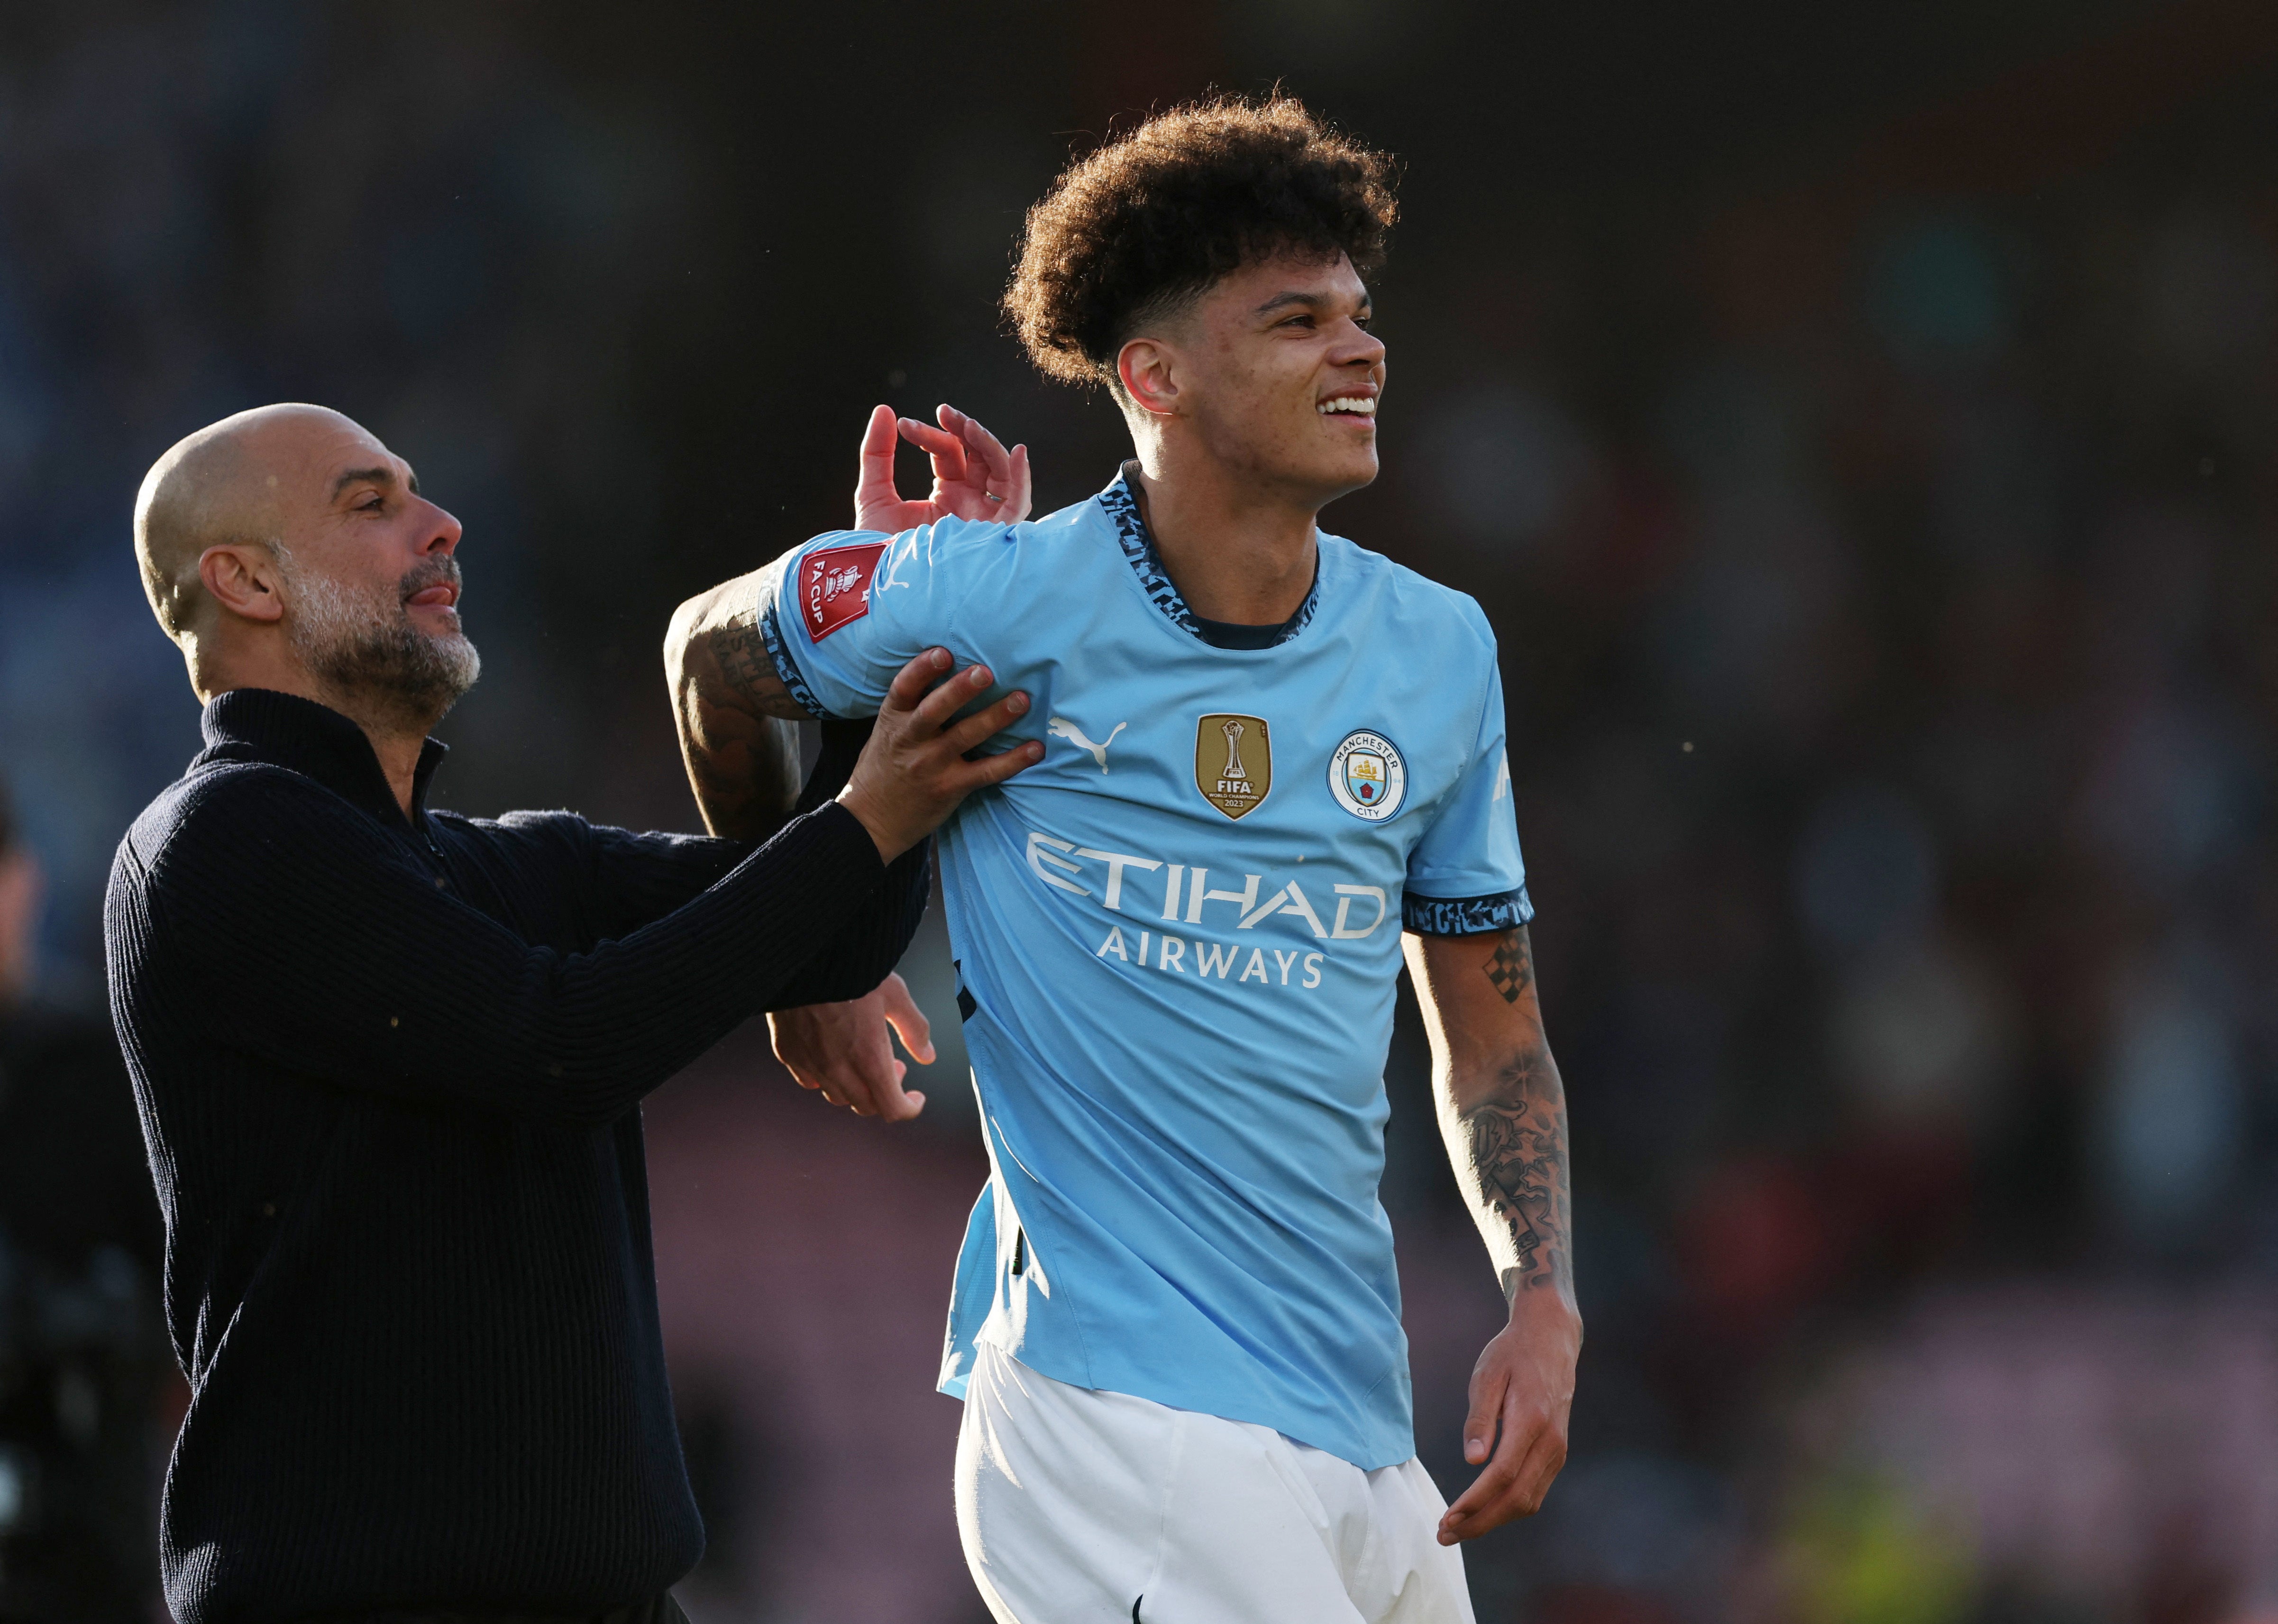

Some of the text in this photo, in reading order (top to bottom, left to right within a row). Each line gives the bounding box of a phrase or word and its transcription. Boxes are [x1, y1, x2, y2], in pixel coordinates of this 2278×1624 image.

[811, 560, 825, 623] FA CUP
[1336, 737, 1398, 769] MANCHESTER
[1357, 807, 1380, 817] CITY
[1025, 831, 1386, 940] ETIHAD
[1096, 925, 1326, 989] AIRWAYS
